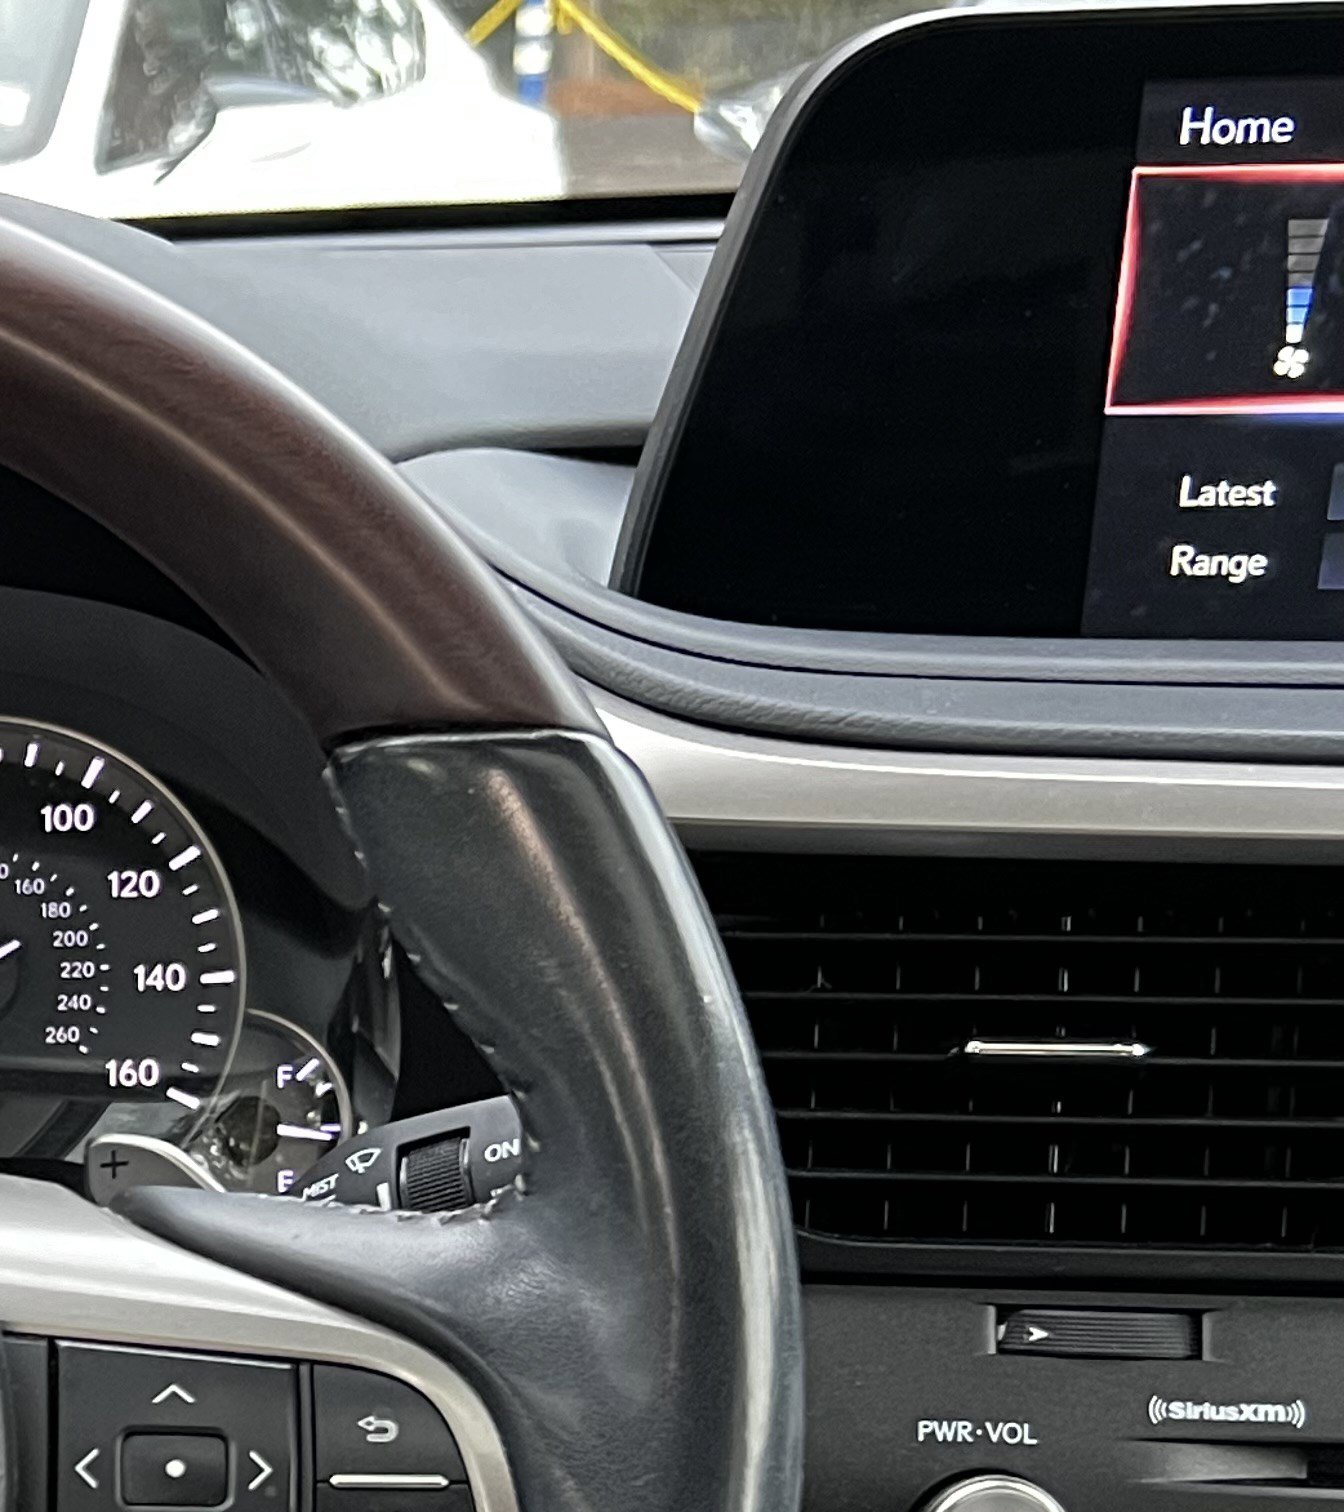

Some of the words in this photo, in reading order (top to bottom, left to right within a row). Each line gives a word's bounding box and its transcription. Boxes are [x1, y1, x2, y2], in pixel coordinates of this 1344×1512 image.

[1179, 106, 1296, 145] Home
[1178, 474, 1278, 508] Latest
[1169, 544, 1269, 583] Range
[40, 803, 95, 833] 100
[14, 878, 46, 895] 160
[107, 869, 161, 898] 120
[40, 901, 71, 918] 180
[52, 929, 88, 947] 200
[60, 960, 95, 979] 220
[133, 962, 187, 992] 140
[57, 993, 92, 1012] 240
[45, 1026, 80, 1044] 260
[105, 1058, 160, 1087] 160
[276, 1064, 294, 1089] F
[484, 1138, 520, 1162] ON
[277, 1169, 294, 1193] E
[302, 1173, 340, 1201] MIST
